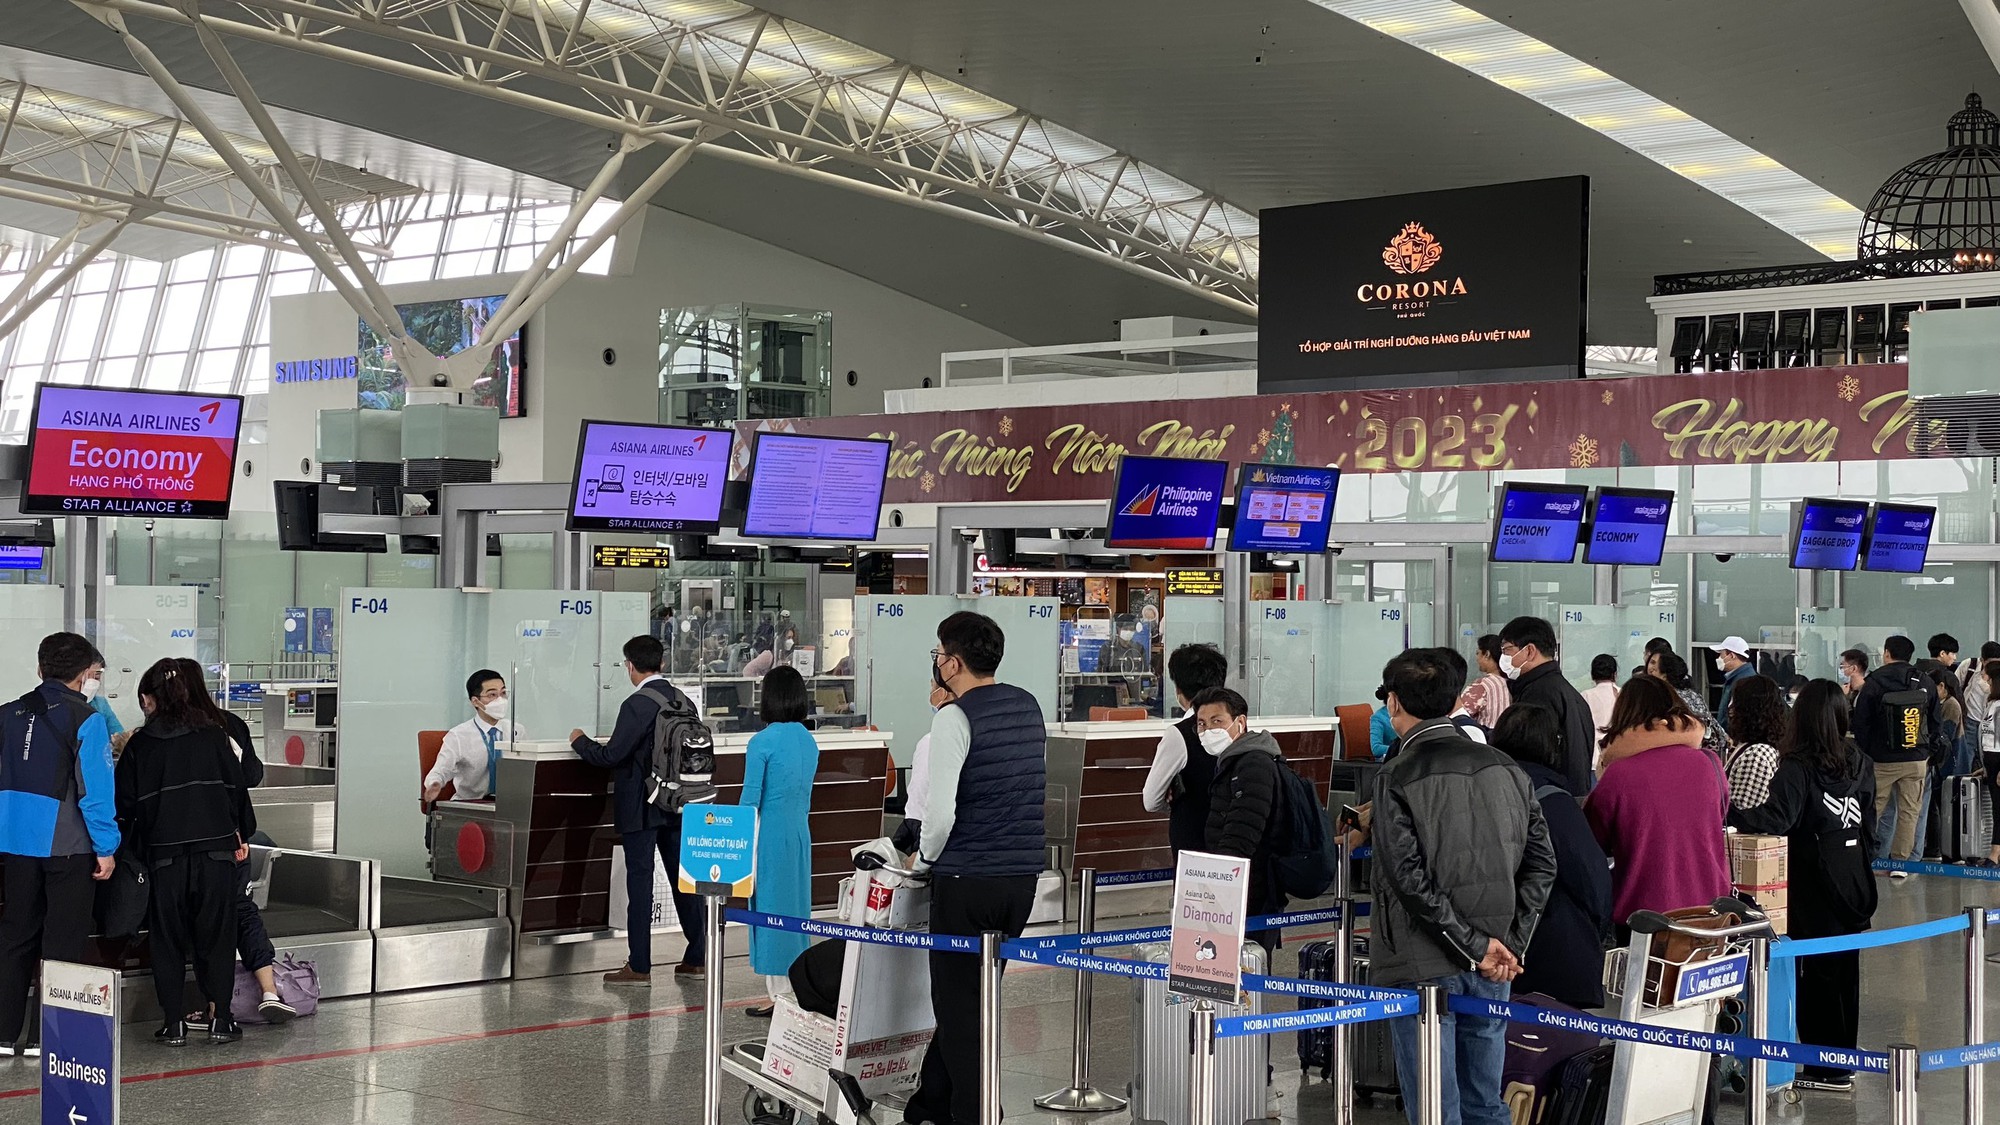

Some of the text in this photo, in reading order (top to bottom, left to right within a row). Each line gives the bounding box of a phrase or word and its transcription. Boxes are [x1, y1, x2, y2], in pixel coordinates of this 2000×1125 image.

[1357, 276, 1467, 302] CORONA
[1392, 300, 1431, 310] RESORT
[1299, 328, 1530, 353] TỔ HỢP GIẢI TRÍ NGHỈ DƯỠNG HÀNG ĐẦU VIỆT NAM
[275, 355, 357, 383] SAMSUNG
[61, 409, 201, 432] ASIANA AIRLINES
[1651, 397, 1839, 464] Happy
[610, 441, 695, 457] ASIANA AIRLINES
[1356, 413, 1506, 470] 2023
[69, 439, 203, 479] Economy
[930, 428, 1034, 493] Mừng
[69, 470, 195, 492] HẠNG PHỔ THÔNG
[632, 469, 709, 489] 인터넷/모바일
[629, 490, 677, 508] 탑승수속
[1161, 485, 1213, 503] Philippine
[62, 497, 177, 514] STAR ALLIANCE
[1157, 502, 1198, 517] Airlines
[1545, 502, 1572, 513] malaysia
[608, 518, 674, 530] STAR ALLIANCE
[1503, 524, 1551, 537] ECONOMY
[1502, 537, 1526, 545] CHECK-IN
[1596, 531, 1640, 543] ECONOMY
[1802, 536, 1856, 548] BAGGAGE DROP
[1873, 541, 1925, 551] PRIORITY COUNTER
[351, 598, 388, 615] F-04
[560, 600, 592, 615] F-05
[877, 603, 904, 617] F-06
[1029, 605, 1053, 618] F-07
[1265, 607, 1286, 620] F-08
[1381, 609, 1400, 621] F-09
[1565, 611, 1582, 623] F-10
[1659, 612, 1675, 623] F-11
[1801, 614, 1815, 624] F-12
[170, 629, 195, 638] ACV
[522, 628, 543, 637] ACV
[833, 629, 850, 637] ACV
[687, 835, 749, 851] VUI LÒNG CHỜ TẠI ĐÂY
[692, 850, 711, 859] PLEASE
[711, 852, 724, 860] WAIT
[724, 853, 738, 861] HERE
[1184, 868, 1233, 882] ASIANA AIRLINES
[1925, 865, 1945, 874] N.I.A
[1963, 868, 1991, 878] NOIBAI
[1185, 889, 1216, 900] Asiana Club
[1183, 904, 1234, 926] Diamond
[1266, 909, 1339, 926] NOIBAI INTERNATIONAL
[767, 916, 970, 949] N.I.A CẢNG HÀNG KHÔNG QUỐC TẾ NỘI BÀI N.I.A
[1039, 926, 1172, 948] N.I.A CẢNG HÀNG KHÔNG QUỐC
[1019, 949, 1038, 961] N.I.A
[1056, 952, 1079, 967] CẢNG
[1080, 956, 1103, 971] HÀNG
[1104, 958, 1133, 974] KHÔNG
[1134, 960, 1158, 978] QUỐC
[1264, 979, 1294, 992] NOIBAI
[1296, 983, 1366, 1000] INTERNATIONAL
[1175, 961, 1234, 979] Happy Mom Service
[49, 986, 102, 1006] ASIANA AIRLINES
[1171, 980, 1234, 996] STAR ALLIANCE GOLD
[1243, 1002, 1402, 1031] NOIBAI INTERNATIONAL AIRPORT N.I.A
[835, 1003, 848, 1056] SV00121
[1489, 1003, 1512, 1017] N.I.A
[1538, 1010, 1567, 1028] CẢNG
[1569, 1015, 1599, 1033] HÀNG
[1601, 1019, 1638, 1039] KHÔNG
[1642, 1027, 1673, 1045] QUỐC
[1676, 1028, 1690, 1046] TẾ
[1692, 1035, 1712, 1051] NỘI
[1716, 1037, 1735, 1052] BÀI
[1762, 1045, 1789, 1058] N.I.A
[1819, 1050, 1859, 1066] NOIBAI
[1928, 1054, 1944, 1065] N.I.A
[49, 1052, 107, 1086] Business
